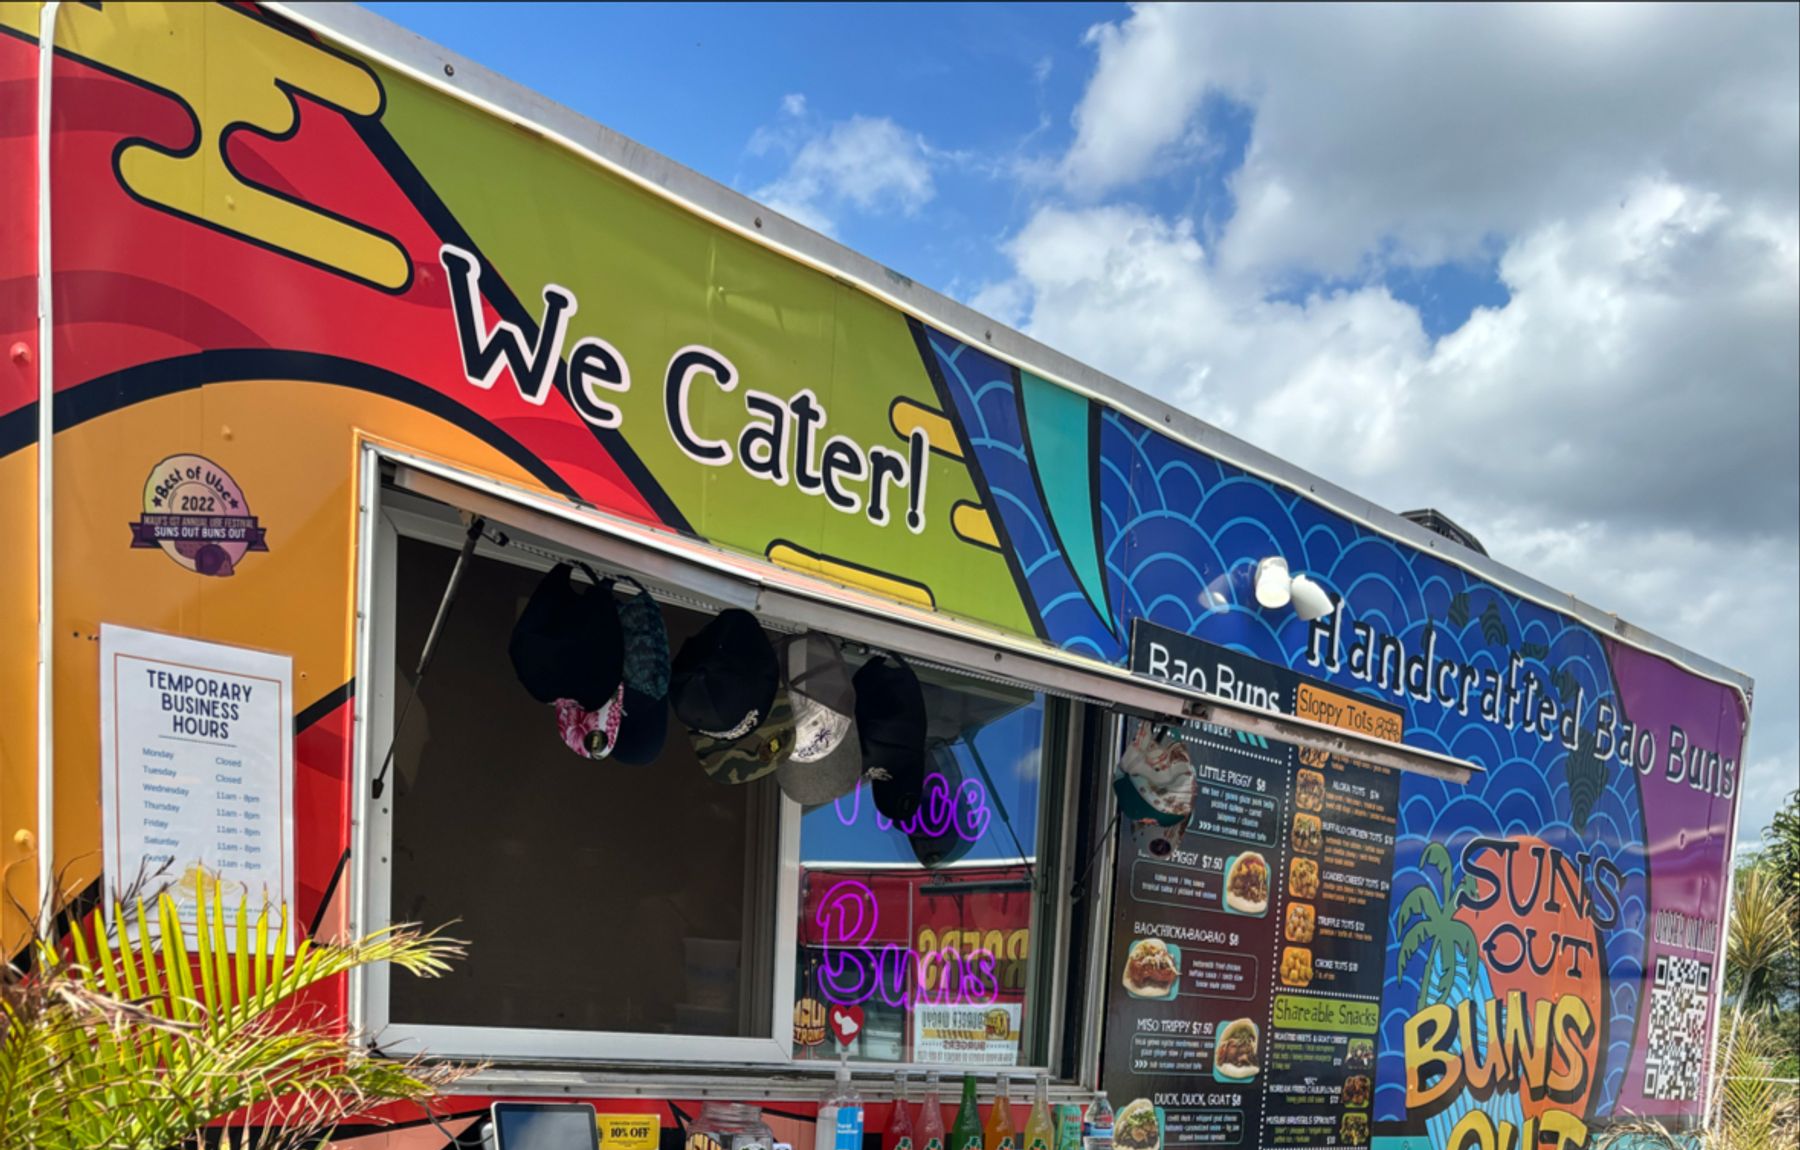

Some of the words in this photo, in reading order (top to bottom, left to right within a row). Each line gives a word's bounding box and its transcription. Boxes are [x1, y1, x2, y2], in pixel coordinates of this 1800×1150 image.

[440, 244, 631, 429] We
[663, 345, 929, 534] Cater!
[154, 468, 183, 499] Best
[186, 466, 202, 480] of
[205, 471, 232, 500] Ube
[181, 496, 215, 512] 2022
[154, 526, 179, 537] SUNS
[181, 527, 200, 537] OUT
[202, 527, 226, 538] BUNS
[228, 528, 246, 538] OUT
[146, 669, 253, 703] TEMPORARY
[1217, 663, 1279, 712] Buns
[1305, 596, 1584, 752] Handcrafted
[1594, 697, 1656, 776] Bao
[1666, 724, 1736, 799] Buns
[161, 693, 240, 721] BUSINESS
[1299, 690, 1343, 727] Sloppy
[1347, 705, 1374, 732] Tots
[172, 715, 229, 740] HOURS
[142, 747, 174, 760] Monday
[215, 757, 242, 767] Closed
[143, 765, 176, 777] Tuesday
[215, 774, 242, 785] Closed
[1199, 765, 1225, 783] LITTLE
[1228, 771, 1252, 788] PIGGY
[1256, 778, 1266, 792] $8
[143, 784, 189, 797] Wednesday
[143, 800, 181, 813] Thursday
[144, 818, 168, 829] Friday
[144, 836, 179, 847] Saturday
[1202, 855, 1223, 870] $7.50
[1455, 836, 1627, 932] SUNS
[816, 881, 998, 1011] Buns
[1229, 933, 1240, 947] $8
[1481, 922, 1593, 979] OUT
[1275, 998, 1334, 1024] Shareable
[1339, 1004, 1377, 1027] Snacks
[1136, 1018, 1158, 1032] MISO
[1161, 1020, 1190, 1034] TRIPPY
[1192, 1021, 1213, 1035] $7.50
[1403, 991, 1597, 1112] BUNS
[1154, 1092, 1179, 1106] DUCK,
[1181, 1093, 1206, 1106] DUCK,
[1208, 1094, 1230, 1106] GOAT
[1231, 1093, 1242, 1107] $8
[630, 1127, 649, 1138] OFF
